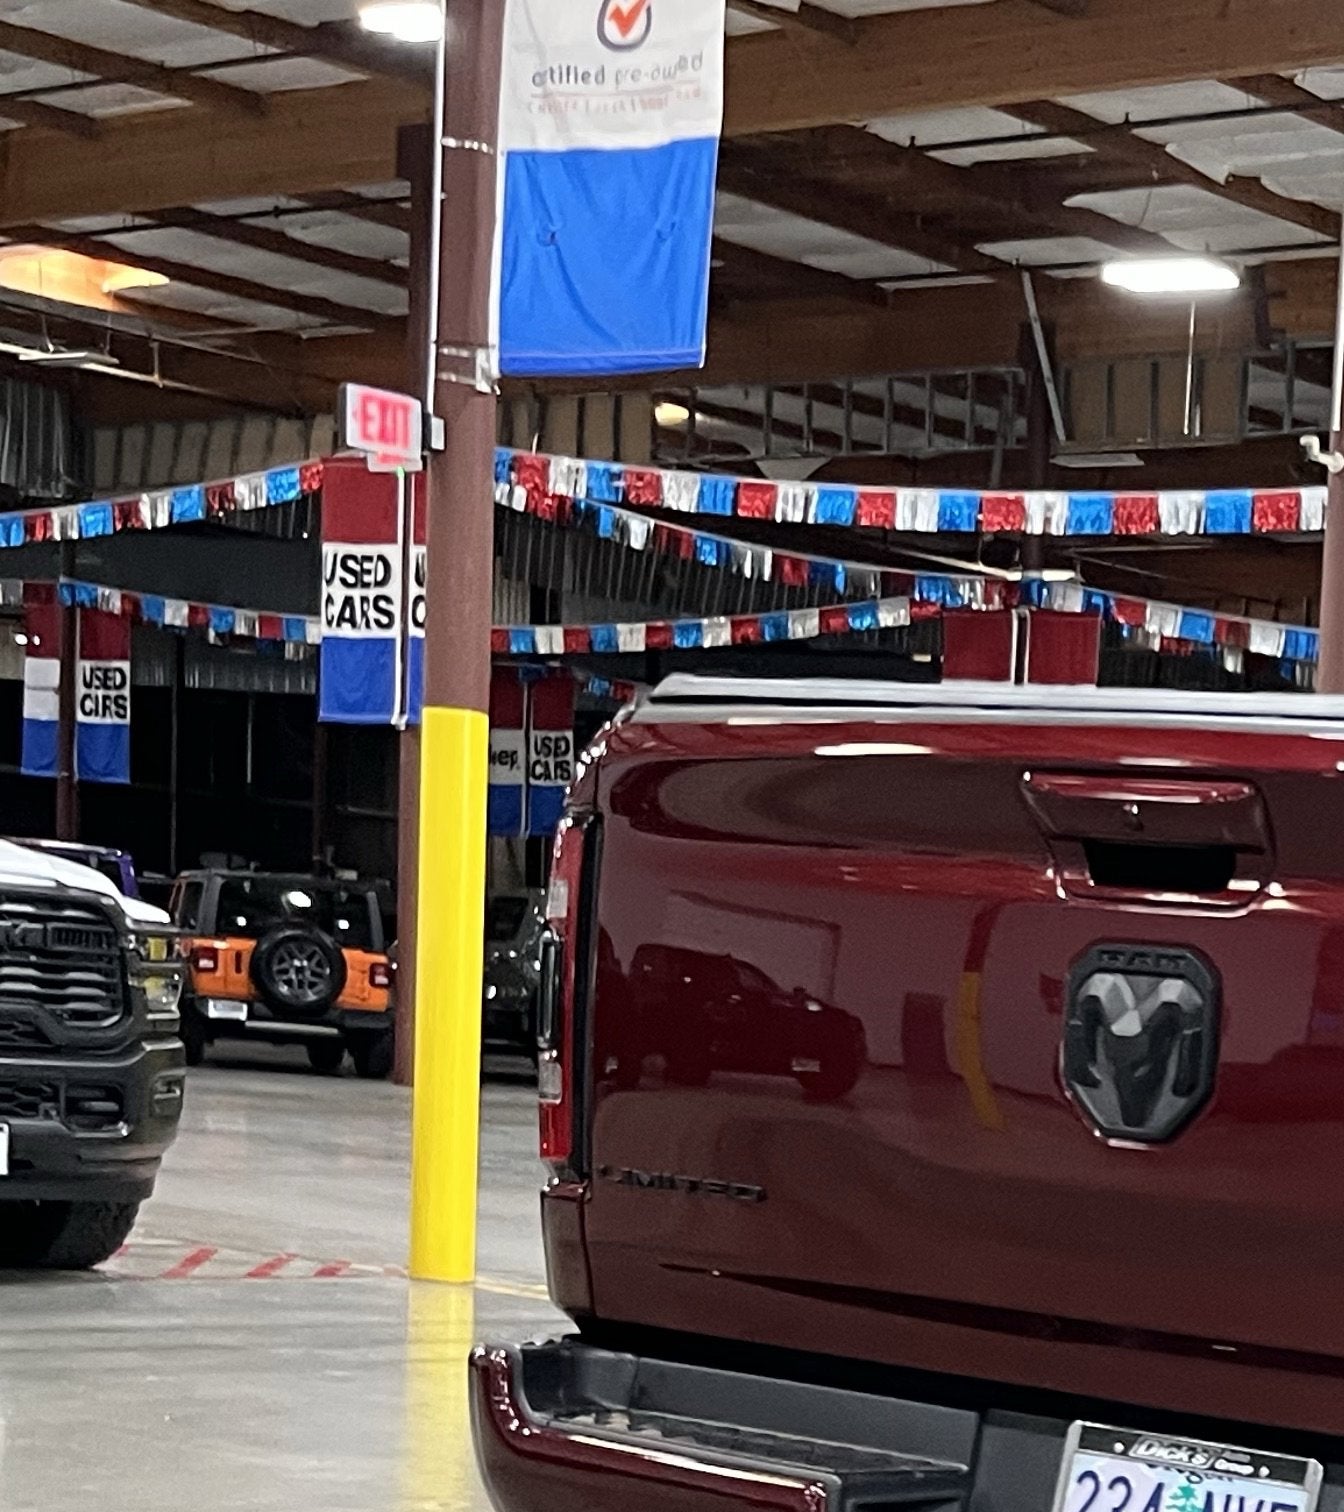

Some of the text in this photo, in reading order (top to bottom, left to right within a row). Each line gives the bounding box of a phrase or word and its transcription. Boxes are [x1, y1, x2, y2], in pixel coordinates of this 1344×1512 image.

[359, 393, 412, 449] EXIT
[324, 551, 392, 589] USED
[325, 592, 396, 630] CARS
[82, 665, 127, 690] USED
